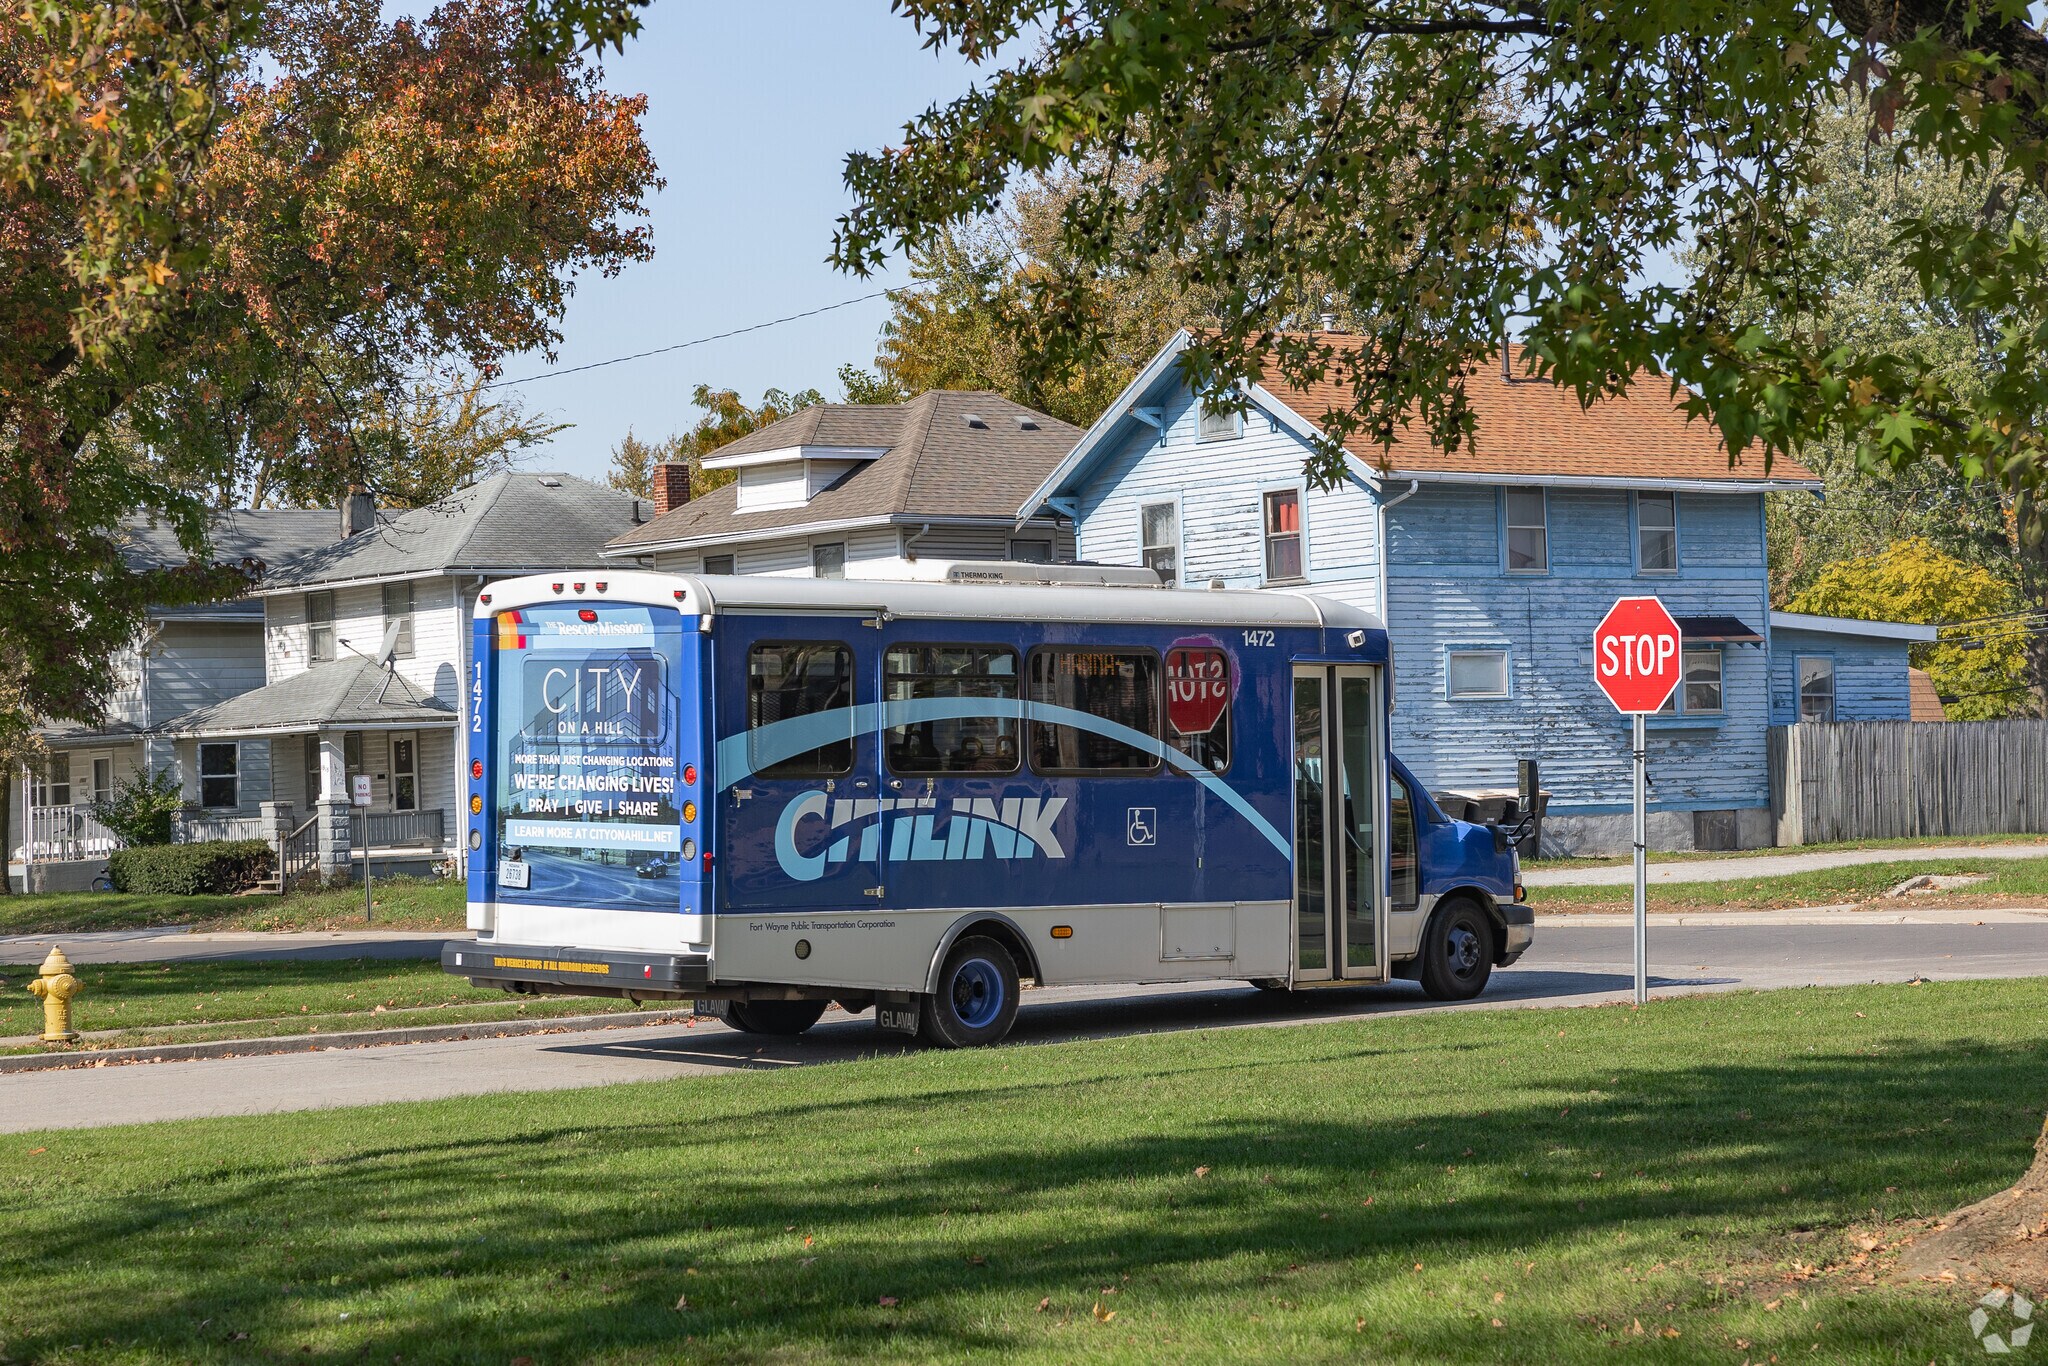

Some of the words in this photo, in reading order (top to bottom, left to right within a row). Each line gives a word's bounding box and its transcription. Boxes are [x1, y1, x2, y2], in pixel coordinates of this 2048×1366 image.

[961, 571, 987, 579] THERMO
[988, 572, 1003, 580] KING
[545, 621, 558, 629] THE
[1241, 630, 1275, 647] 1472
[1601, 634, 1675, 677] STOP
[473, 661, 482, 733] 1472
[543, 668, 642, 713] CITY
[558, 721, 575, 734] ON
[581, 721, 589, 734] A
[595, 721, 623, 734] HILL
[514, 754, 537, 764] MORE
[538, 754, 560, 765] THAN
[561, 755, 581, 766] JUST
[582, 755, 624, 767] CHANGING
[626, 756, 674, 767] LOCATIONS
[514, 774, 555, 790] WE'RE
[559, 775, 629, 792] CHANGING
[632, 776, 674, 793] LIVES!
[528, 798, 559, 813] PRAY
[575, 799, 602, 814] GIVE
[618, 800, 658, 816] SHARE
[514, 826, 544, 838] LEARN
[547, 827, 573, 839] MORE
[575, 828, 587, 839] AT
[589, 829, 673, 842] CITYONAHILL.NET
[774, 790, 1068, 881] CITILINK
[750, 923, 763, 931] Fort
[765, 922, 789, 933] Wayne
[791, 920, 810, 930] Public
[811, 920, 856, 932] Transportation
[857, 919, 896, 931] Corporation
[494, 957, 507, 967] THIS
[506, 958, 526, 968] VEHICLE
[526, 959, 542, 970] STOPS
[543, 960, 549, 970] AT
[549, 960, 558, 971] ALL
[558, 961, 581, 972] RAILROAD
[582, 963, 609, 974] CROSSINGS
[880, 1010, 916, 1031] GLAVAL
